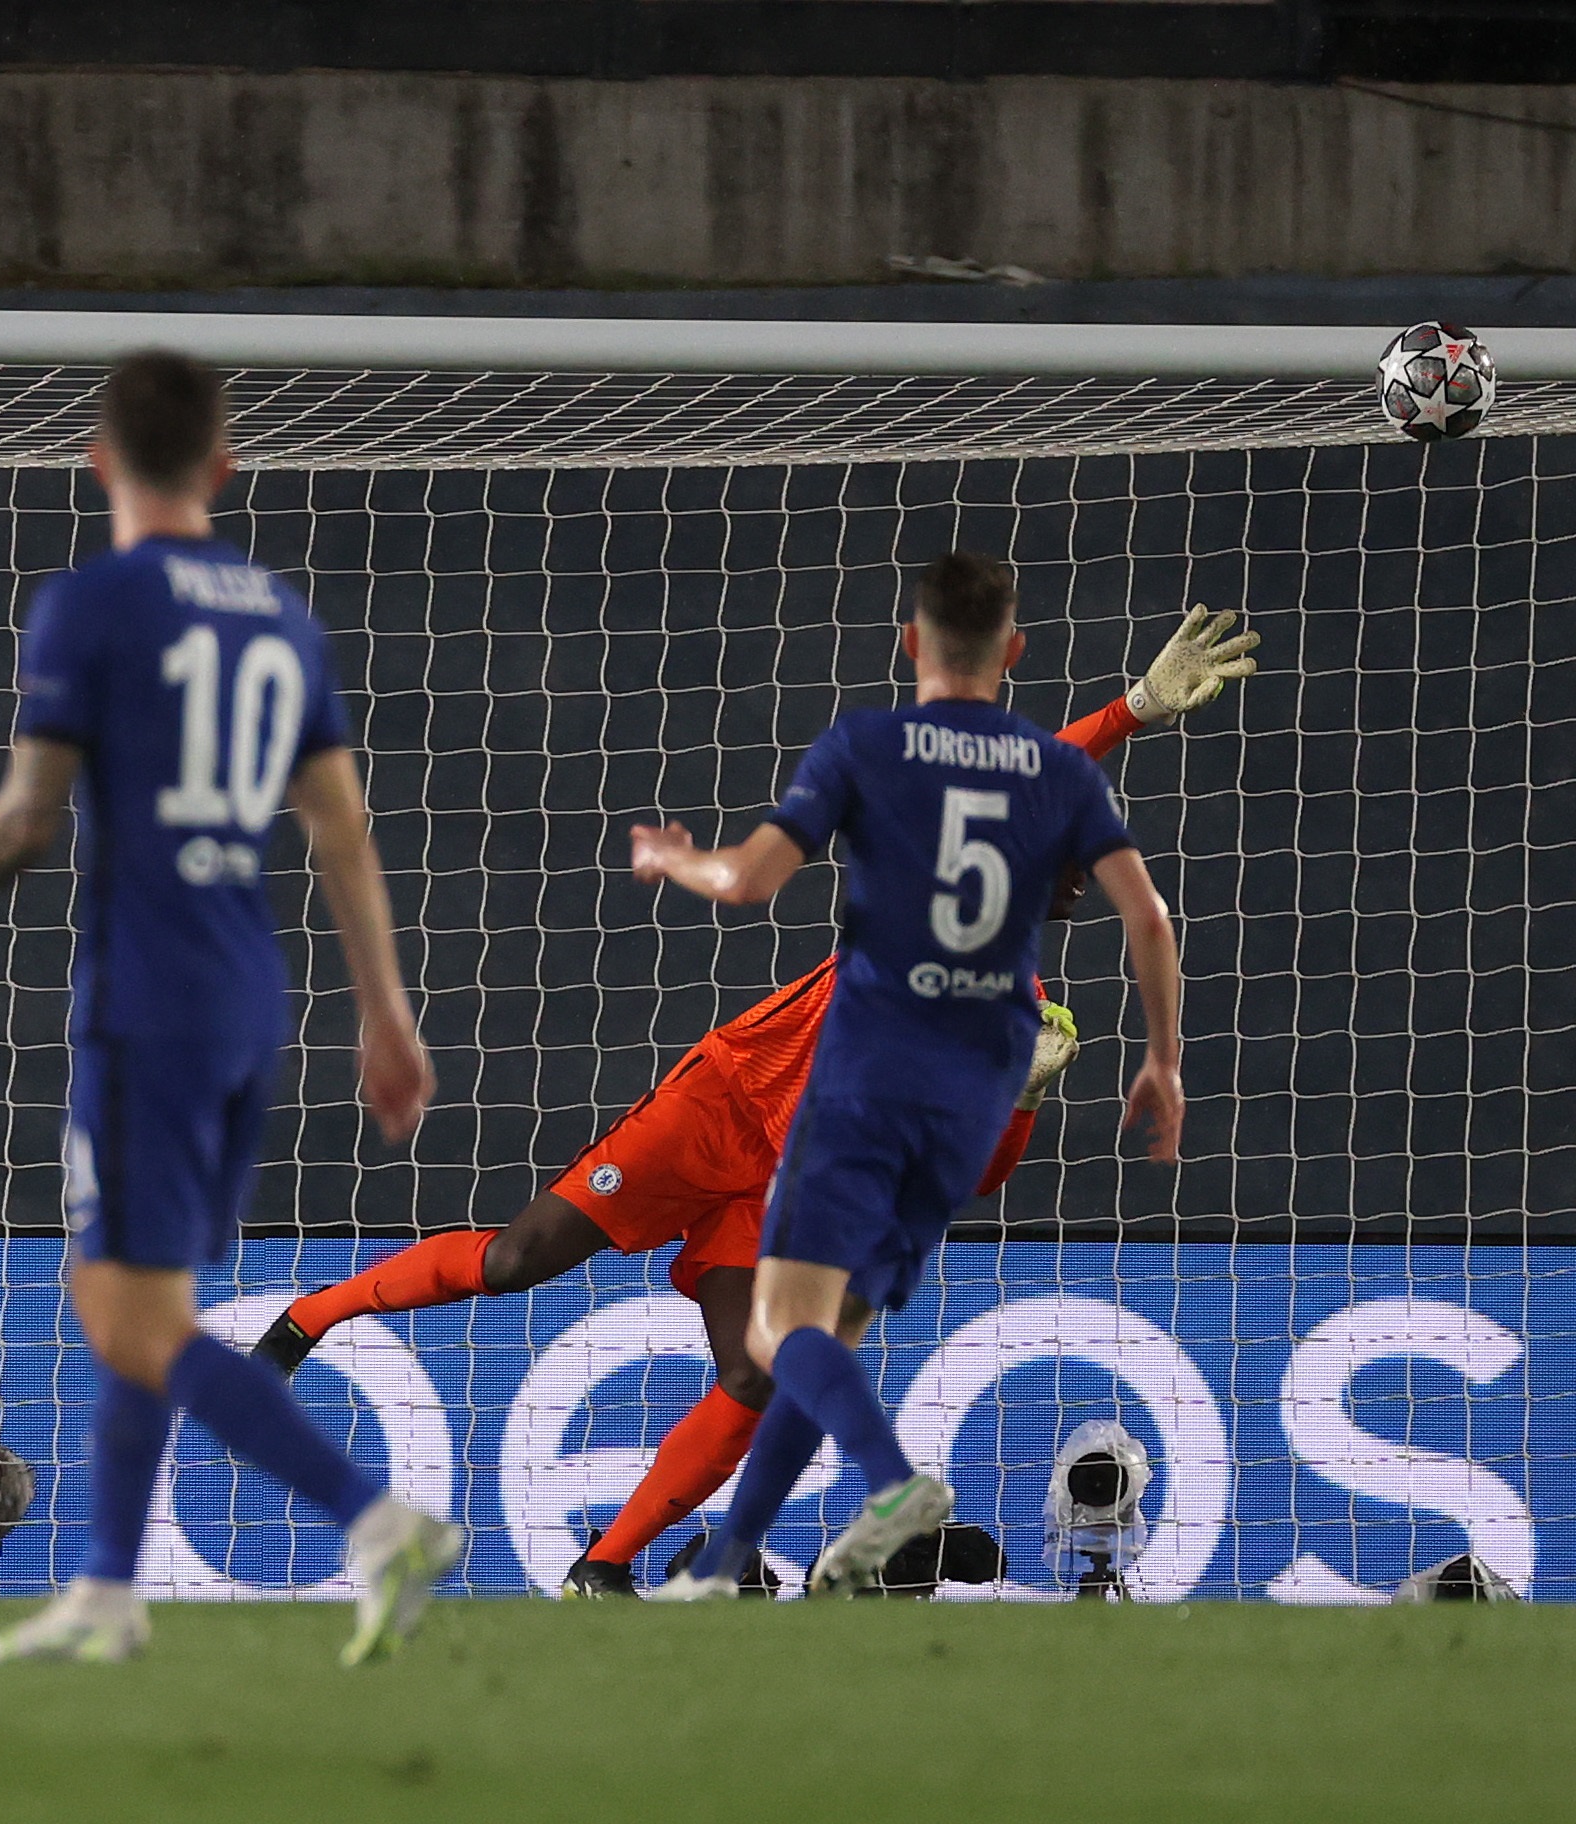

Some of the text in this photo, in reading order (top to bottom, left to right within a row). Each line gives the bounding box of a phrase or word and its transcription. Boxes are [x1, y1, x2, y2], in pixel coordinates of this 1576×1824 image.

[157, 624, 304, 833] 10
[903, 722, 1042, 778] JORGINHO
[930, 786, 1012, 953] 5
